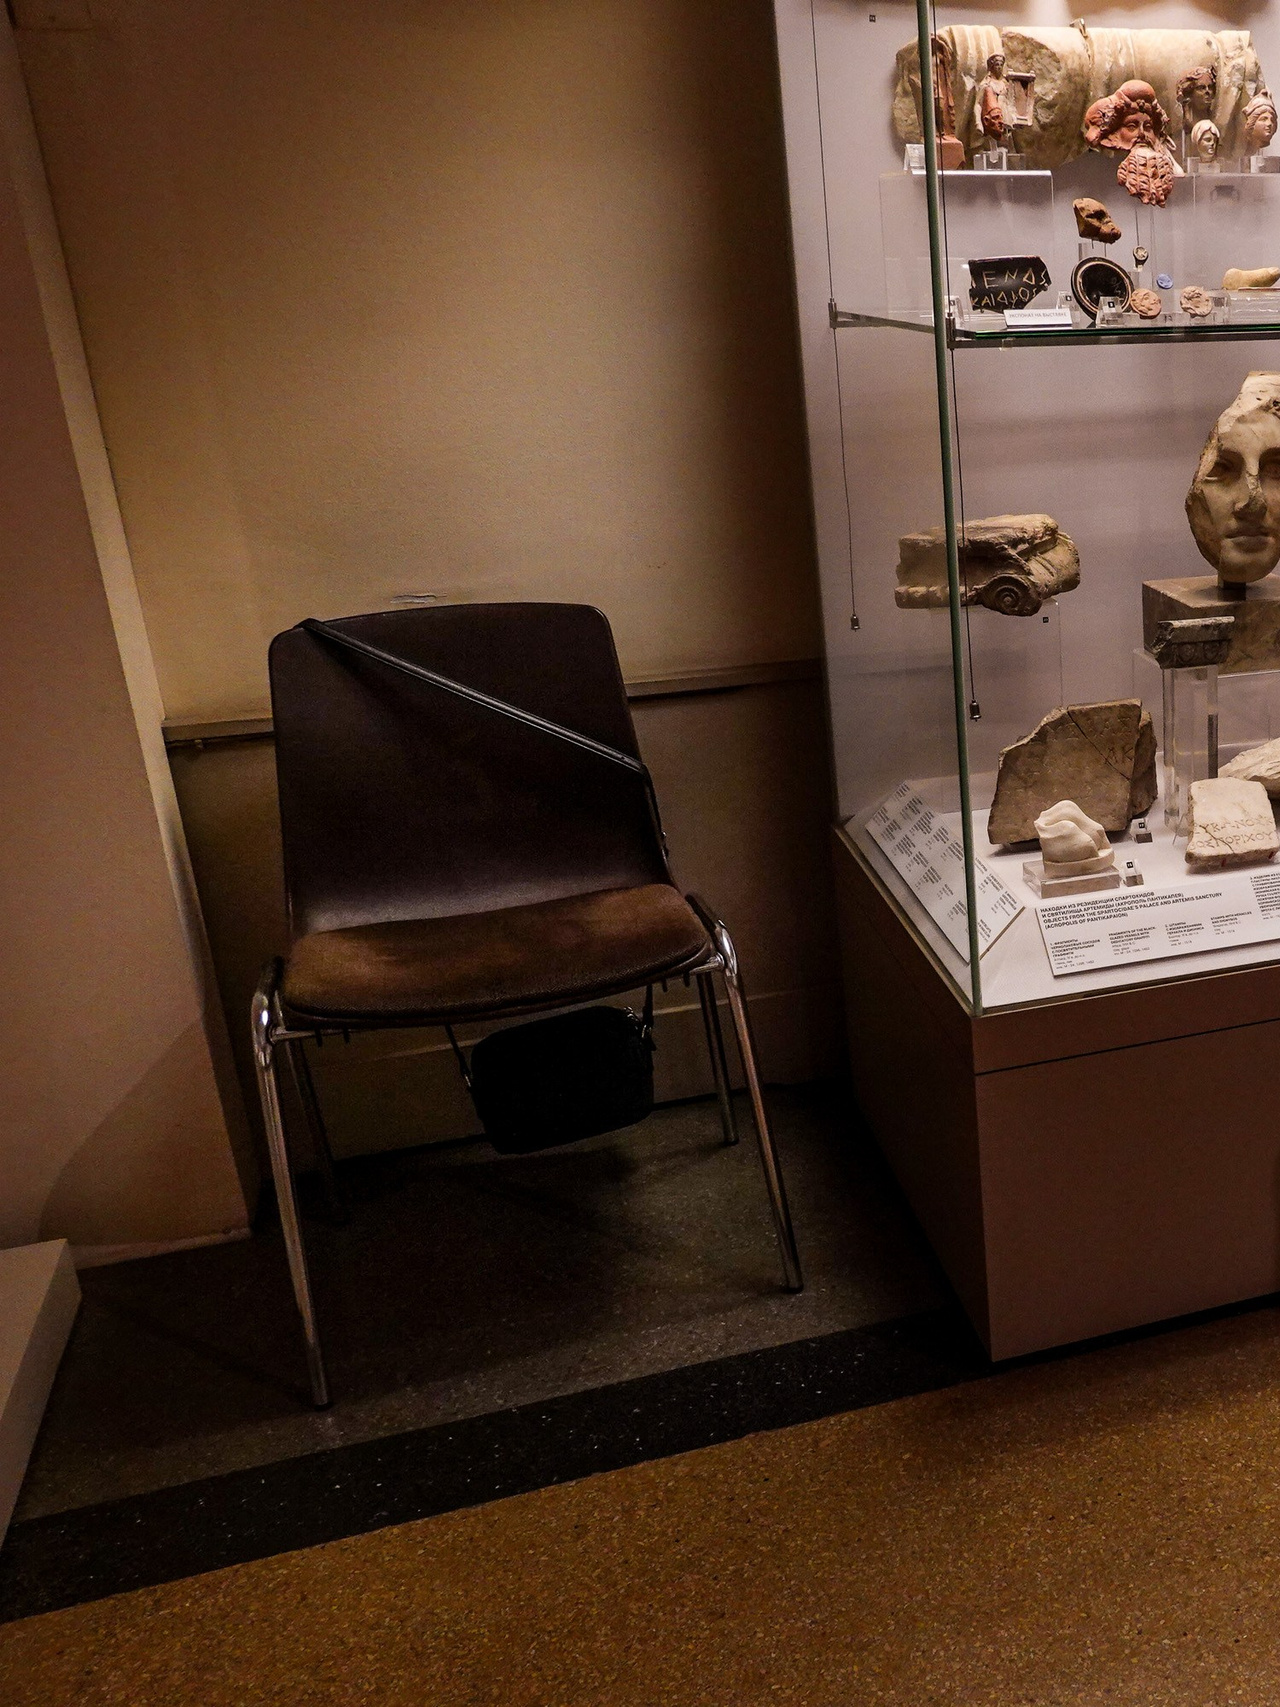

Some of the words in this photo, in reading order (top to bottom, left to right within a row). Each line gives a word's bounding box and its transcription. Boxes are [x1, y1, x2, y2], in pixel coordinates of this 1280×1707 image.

[1040, 905, 1067, 913] НАХОДКИ
[1077, 898, 1114, 907] РЕЗИДЕНЦИИ
[1114, 892, 1155, 902] СПАРТОКИДОВ
[1043, 915, 1069, 923] OBJECTS
[1172, 897, 1195, 905] ARTEMIS
[1046, 908, 1083, 917] СВЯТИЛИЩА
[1083, 903, 1115, 912] АРТЕМИДЫ
[1044, 920, 1079, 929] (ACROPOLIS
